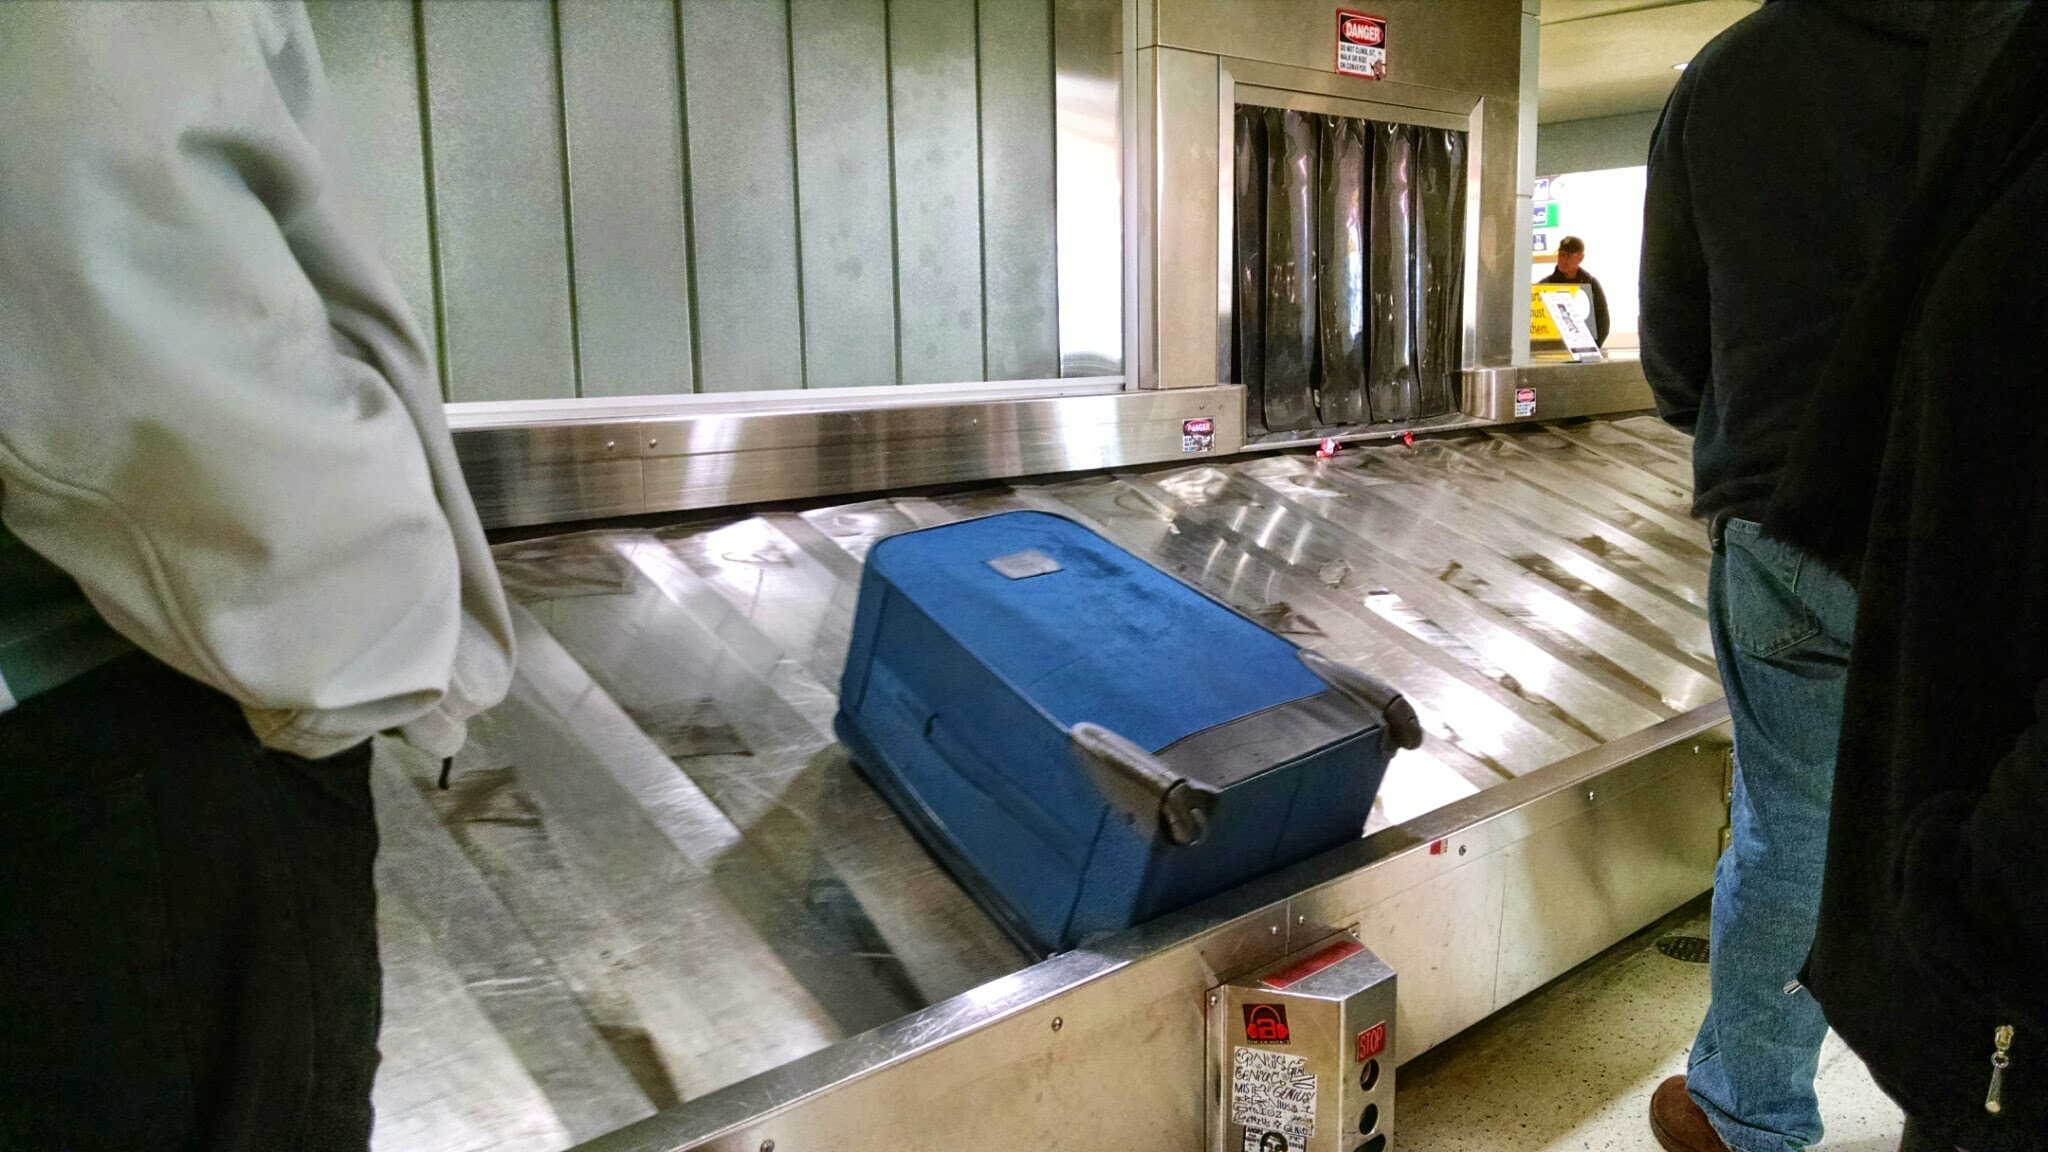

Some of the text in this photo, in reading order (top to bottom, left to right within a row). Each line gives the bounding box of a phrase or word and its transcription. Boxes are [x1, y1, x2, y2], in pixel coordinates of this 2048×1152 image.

[1345, 22, 1381, 42] DANGER
[1347, 45, 1355, 53] NOT
[1340, 53, 1351, 61] WALK
[1352, 54, 1358, 62] OR
[1187, 422, 1211, 432] DANGER
[1360, 1026, 1383, 1058] STOP
